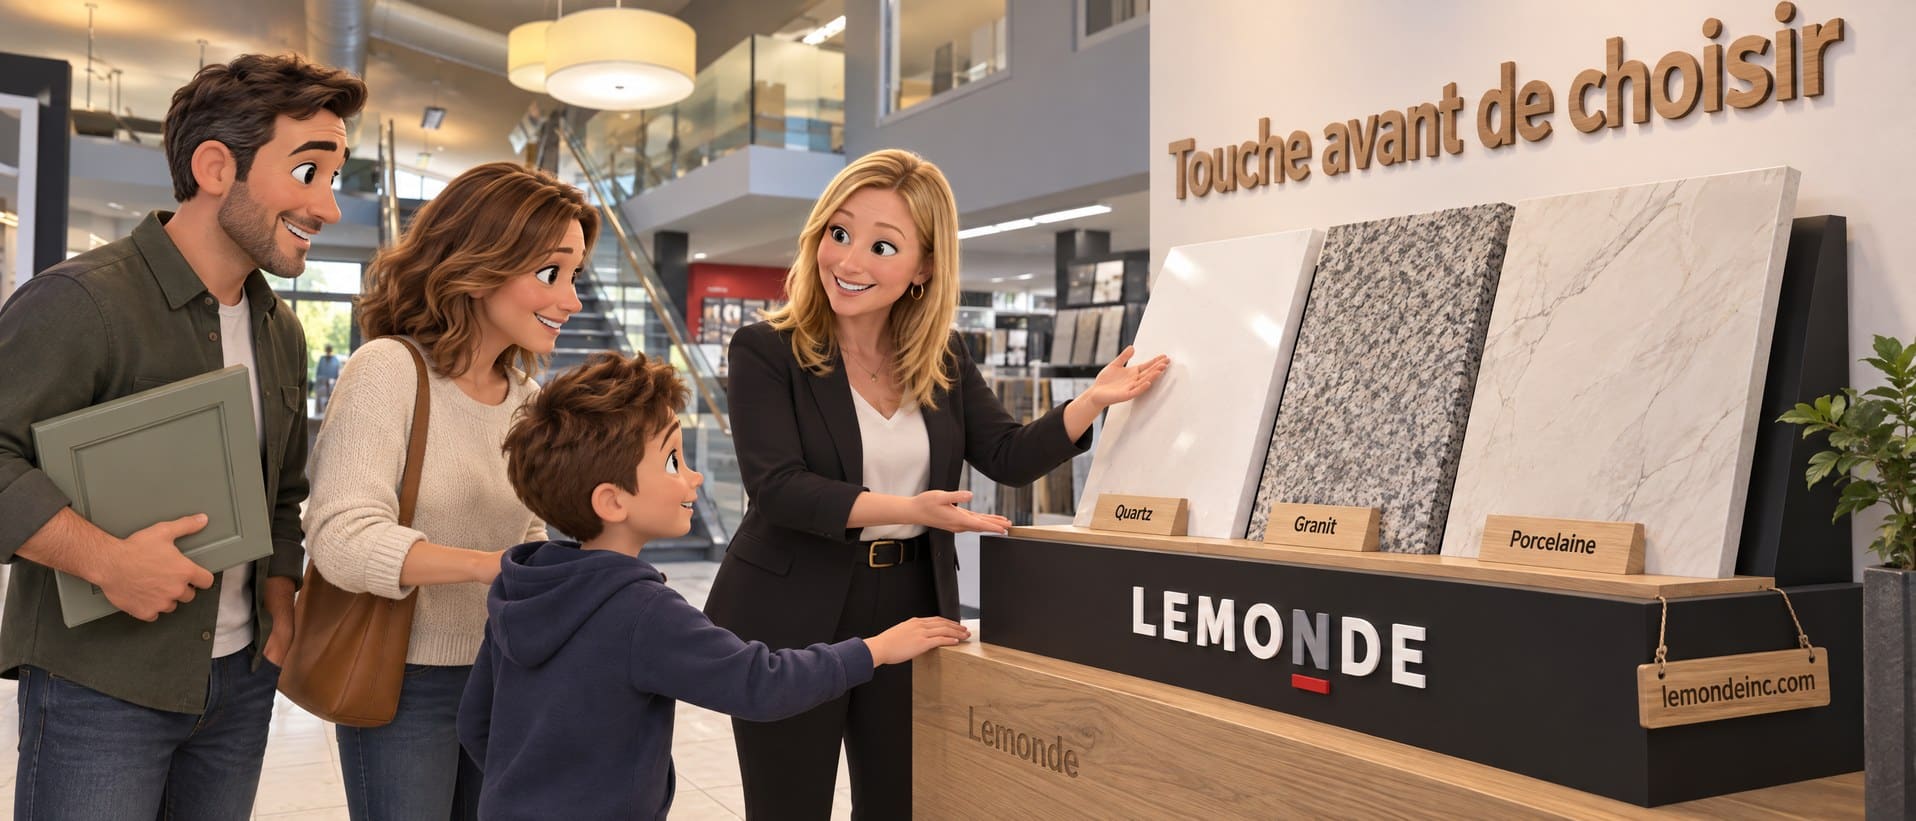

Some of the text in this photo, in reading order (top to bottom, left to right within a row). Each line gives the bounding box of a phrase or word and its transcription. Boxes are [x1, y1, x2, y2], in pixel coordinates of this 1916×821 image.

[1168, 1, 1844, 200] Touche avant de choisir
[1115, 504, 1153, 521] Quartz
[1294, 516, 1337, 535] Granit
[1509, 530, 1596, 554] Porcelaine
[1132, 586, 1426, 689] LEMONDE
[1662, 673, 1815, 708] lemondeinc.com
[968, 706, 1079, 778] Lemonde
